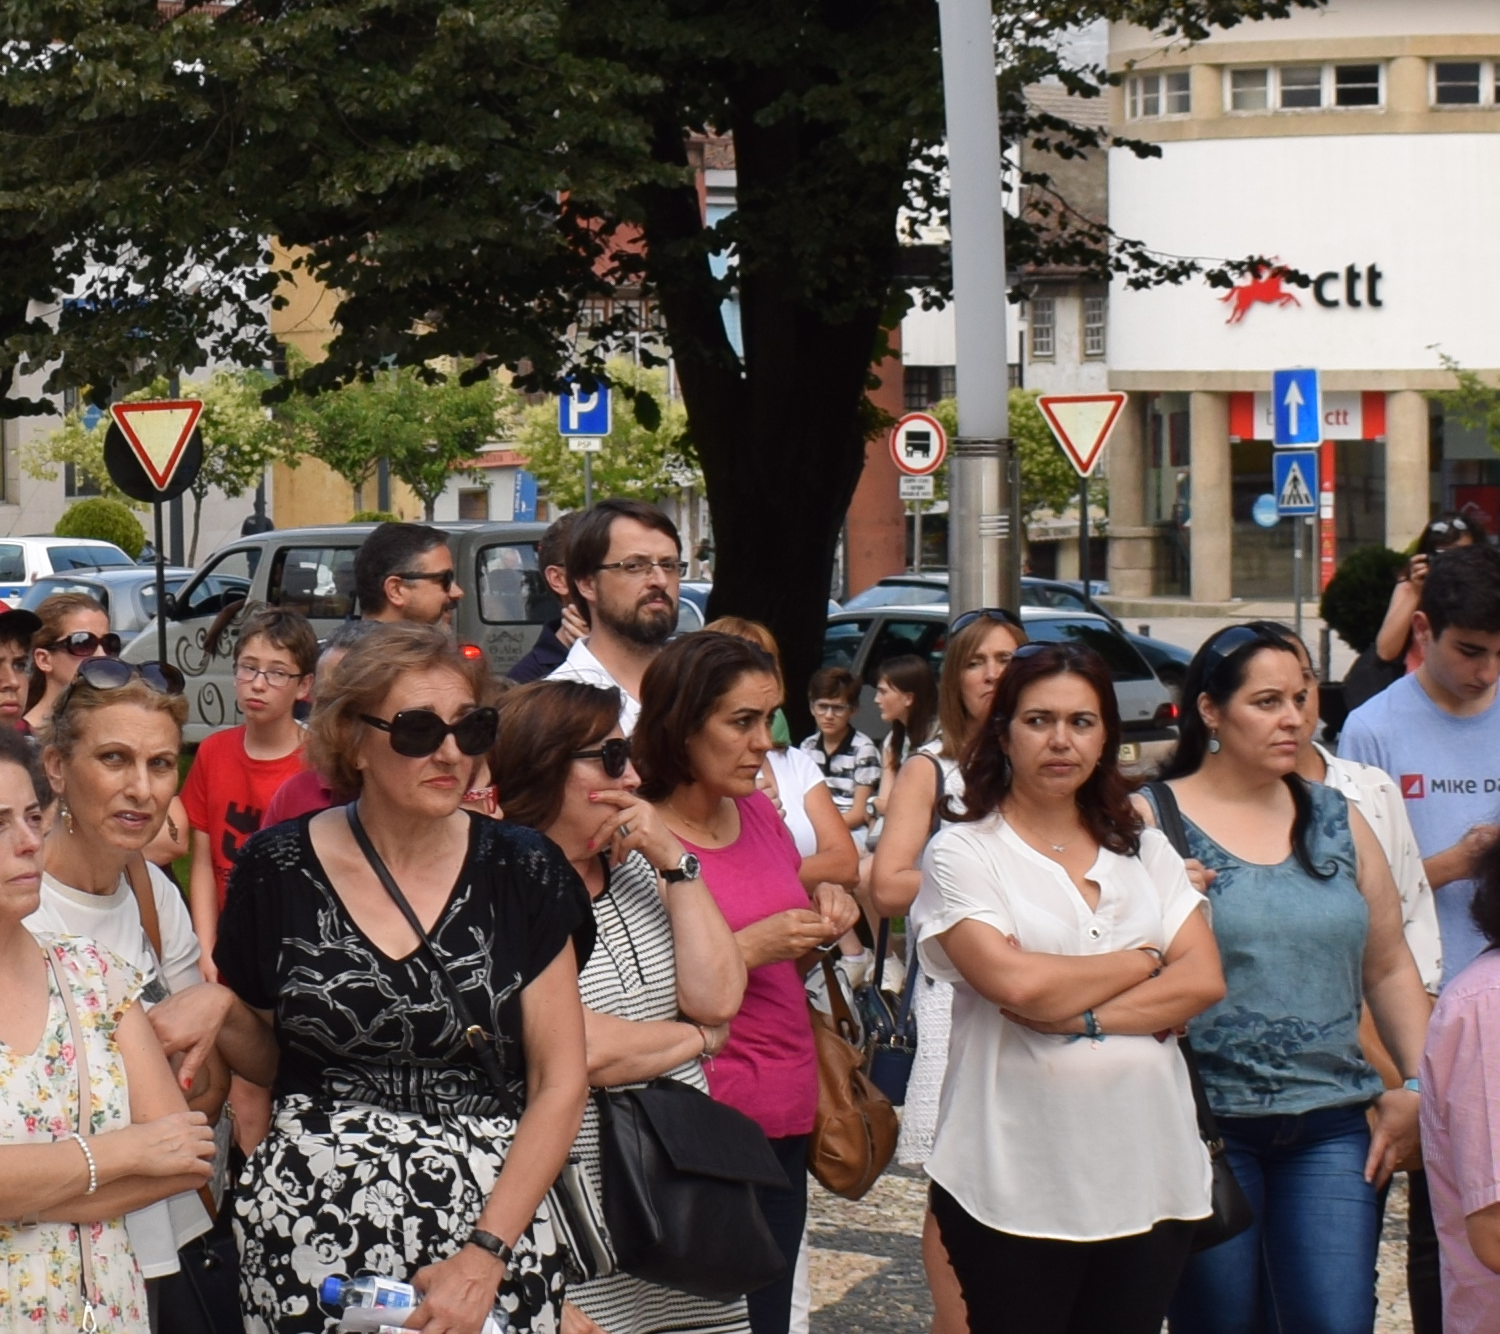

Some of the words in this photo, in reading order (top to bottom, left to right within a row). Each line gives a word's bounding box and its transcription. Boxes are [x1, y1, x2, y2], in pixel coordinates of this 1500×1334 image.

[1312, 262, 1383, 308] ctt
[569, 382, 599, 430] P
[1324, 409, 1349, 426] ctt
